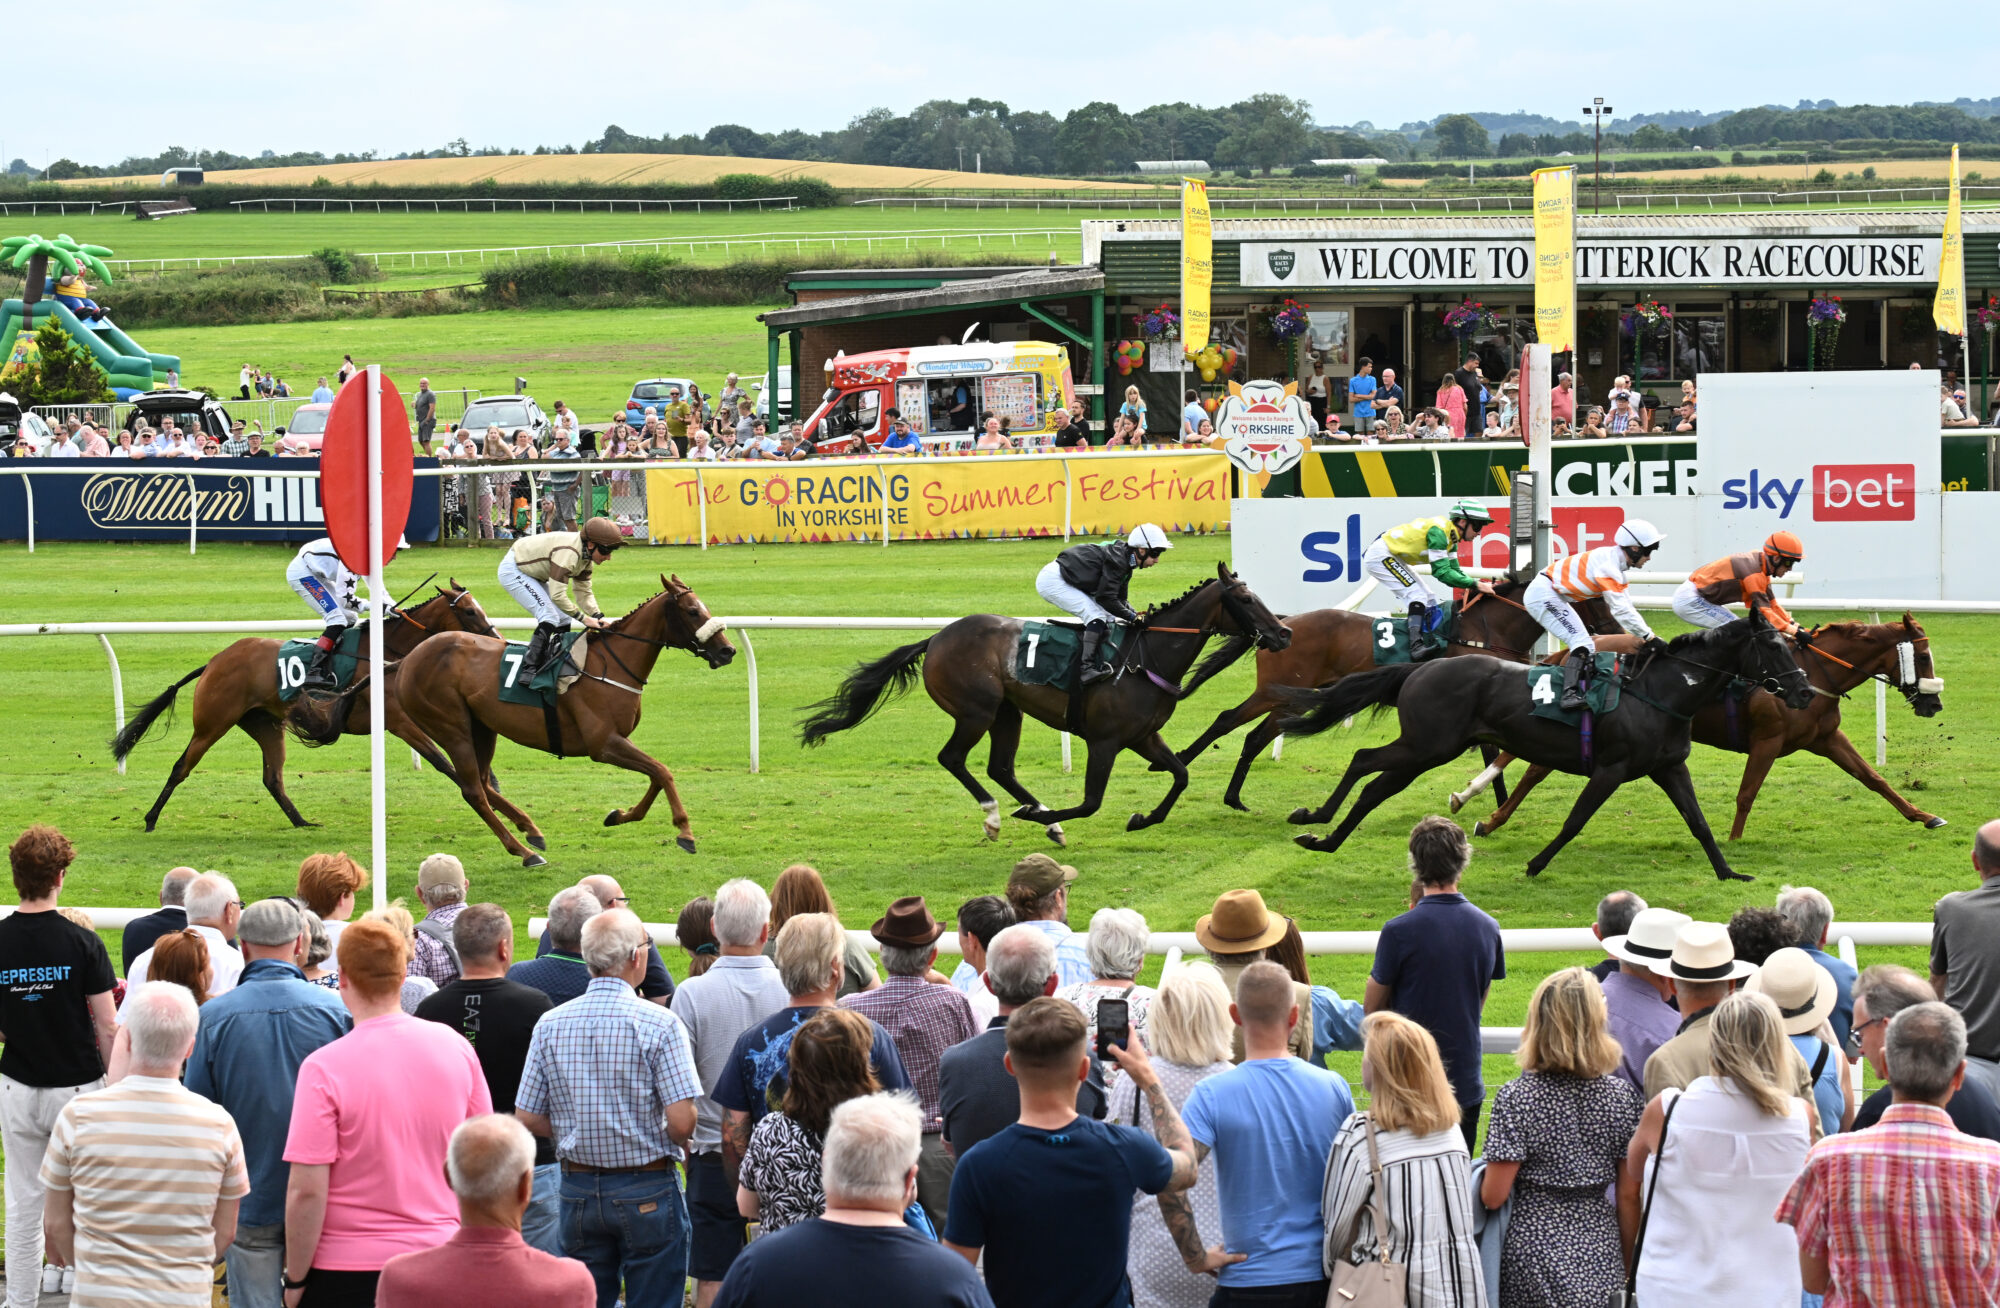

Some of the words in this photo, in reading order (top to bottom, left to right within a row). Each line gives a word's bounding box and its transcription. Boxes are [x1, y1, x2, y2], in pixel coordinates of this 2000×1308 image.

[1319, 247, 1477, 280] WELCOME
[1488, 247, 1529, 280] TO
[1576, 245, 1712, 278] TTERICK
[1723, 244, 1925, 278] RACECOURSE
[924, 361, 959, 371] Wonderful
[961, 360, 985, 371] Whippy
[1232, 424, 1295, 436] YORKSHIRE
[82, 474, 250, 522] William
[254, 477, 325, 522] HIL
[674, 478, 730, 507] The
[922, 479, 1066, 517] Summer
[1079, 468, 1228, 503] Festival
[1722, 469, 1804, 519] sky
[1824, 470, 1905, 508] bet
[777, 505, 795, 527] IN
[800, 508, 909, 527] YORKSHIRE
[1388, 557, 1415, 584] VICKERS
[1376, 621, 1396, 649] 3
[1558, 616, 1579, 635] ENERGY
[1026, 633, 1041, 668] 1
[278, 655, 306, 690] 10
[504, 653, 524, 689] 7
[1531, 673, 1556, 704] 4
